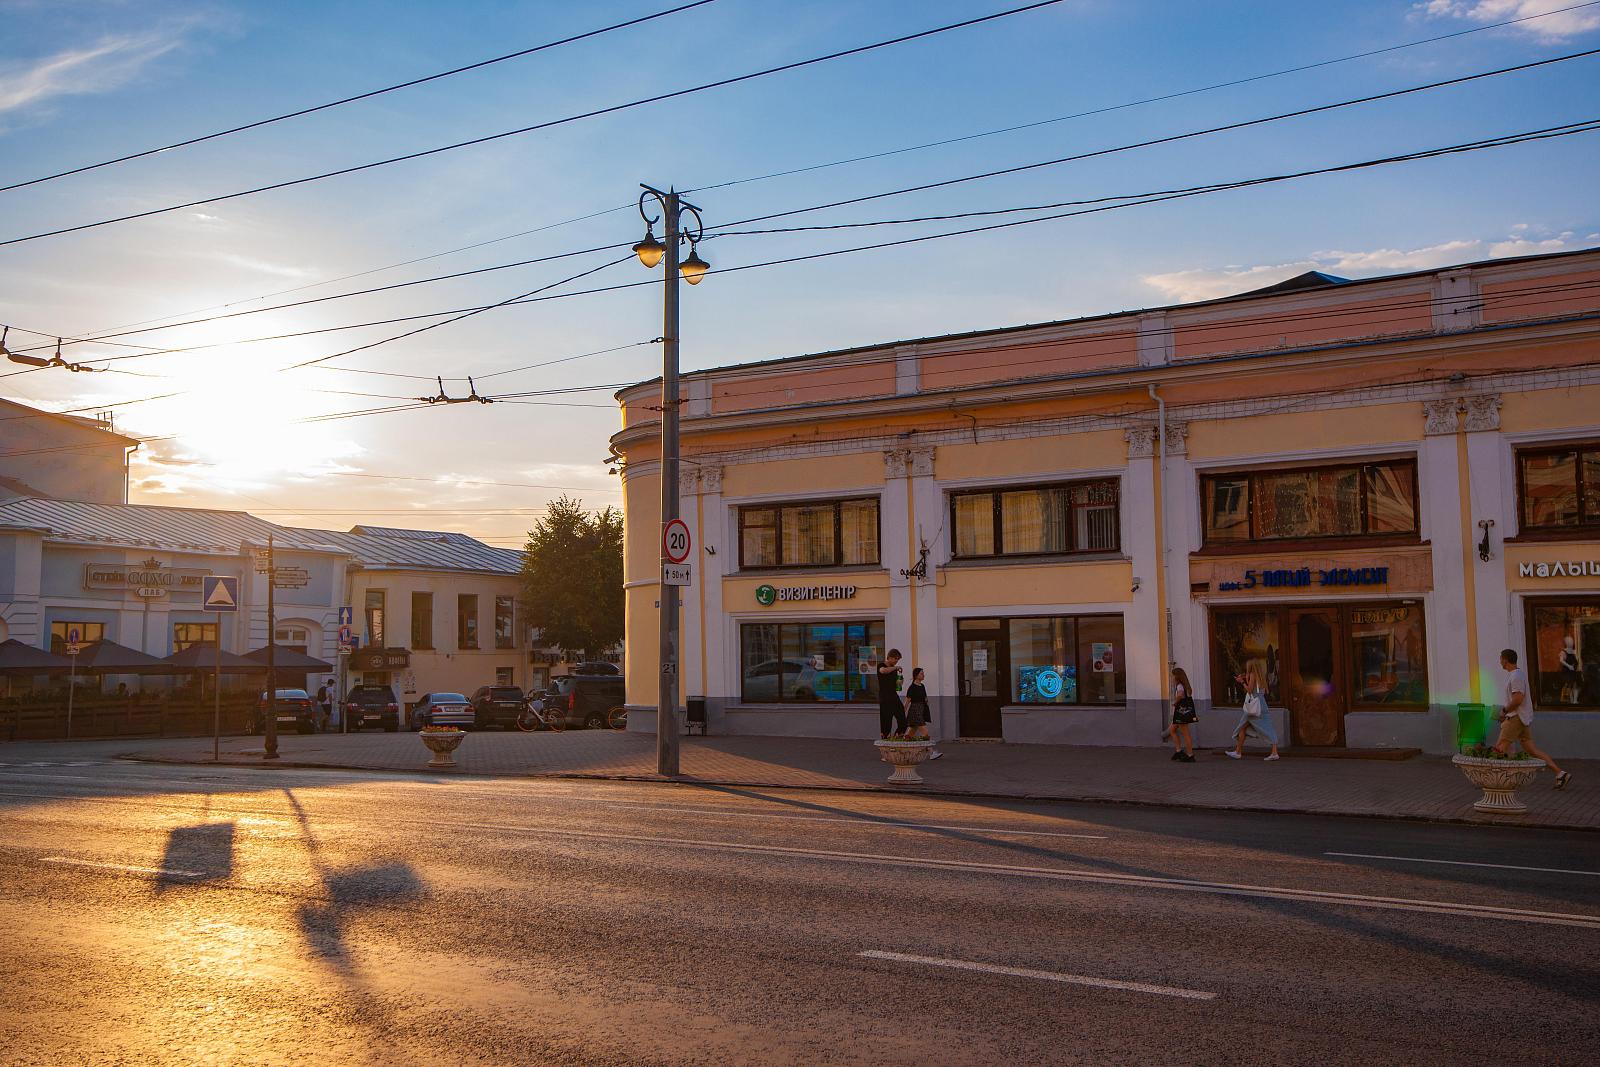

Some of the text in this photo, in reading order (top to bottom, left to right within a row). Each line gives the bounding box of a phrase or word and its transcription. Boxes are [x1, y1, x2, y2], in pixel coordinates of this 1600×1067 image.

[670, 533, 685, 550] 20
[127, 571, 173, 586] СОХО
[1244, 569, 1257, 589] 5
[778, 585, 857, 602] ВИЗИТ-ЦЕНТР
[662, 663, 677, 674] 21
